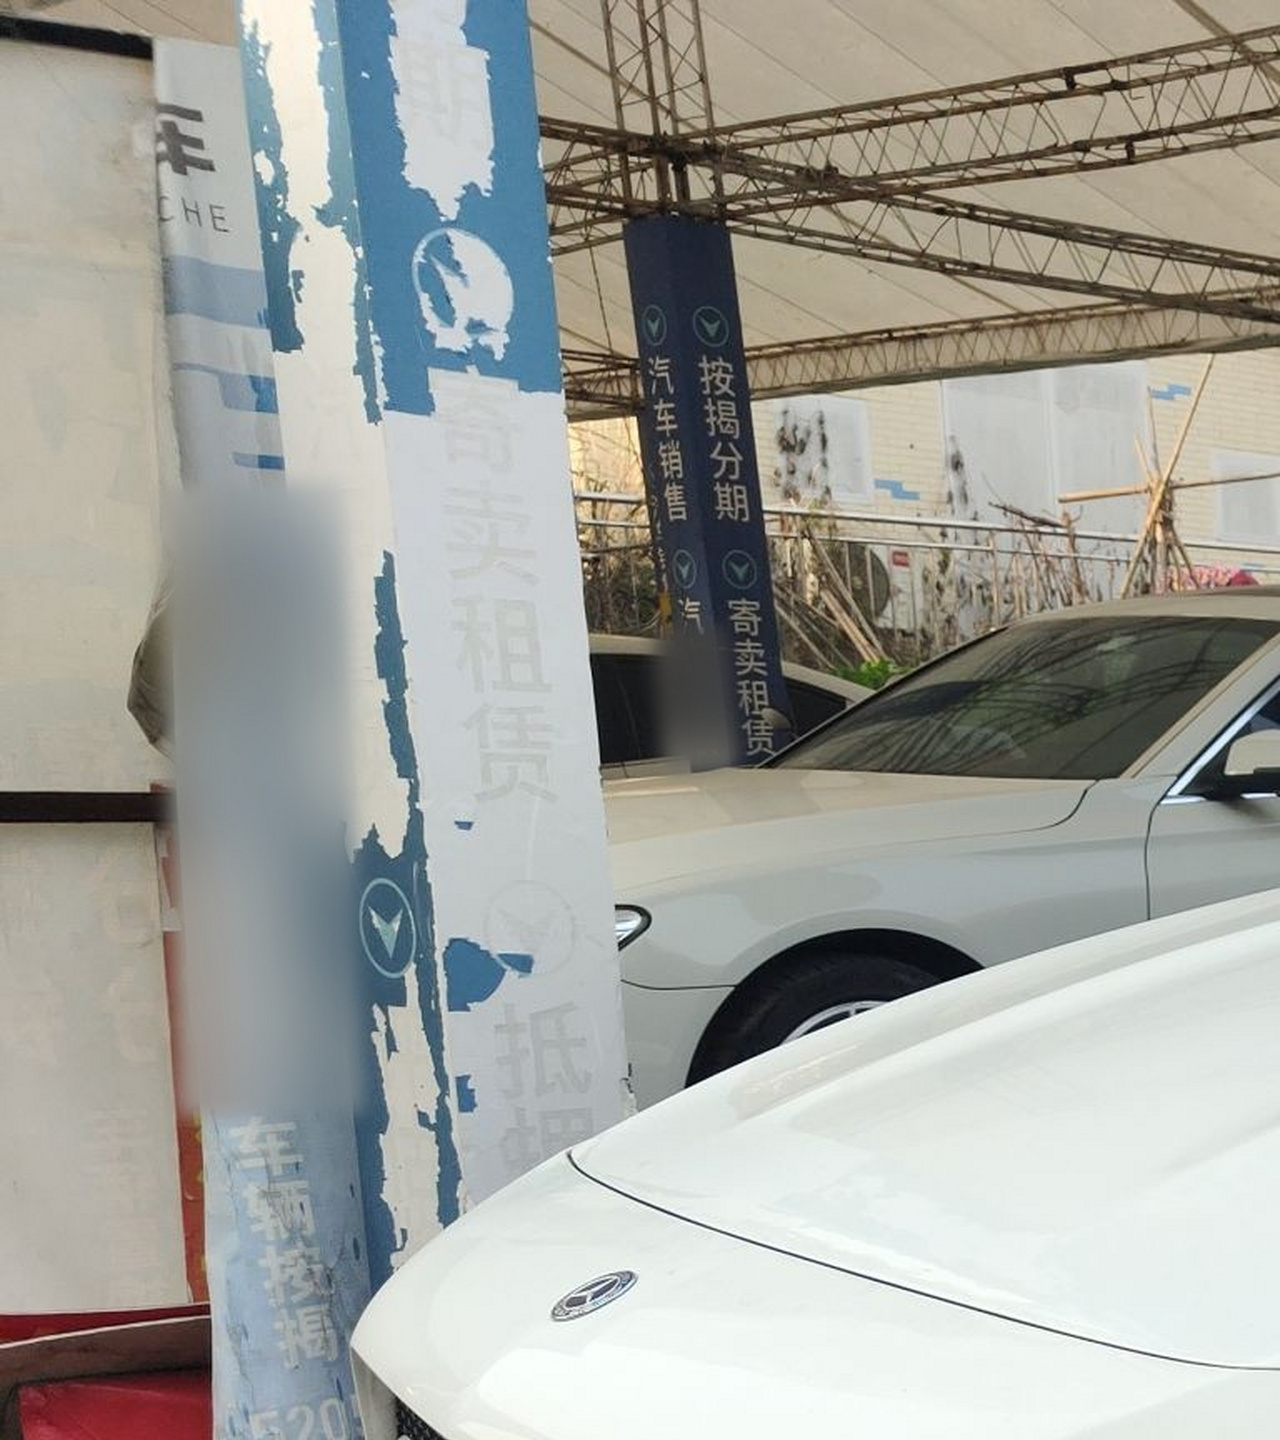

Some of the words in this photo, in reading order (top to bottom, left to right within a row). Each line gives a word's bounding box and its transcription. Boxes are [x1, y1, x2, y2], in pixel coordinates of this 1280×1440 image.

[648, 356, 687, 521] 汽车销售
[698, 354, 751, 523] 按揭分期
[727, 598, 777, 757] 寄卖租赁
[230, 1116, 339, 1370] 车辆按揭
